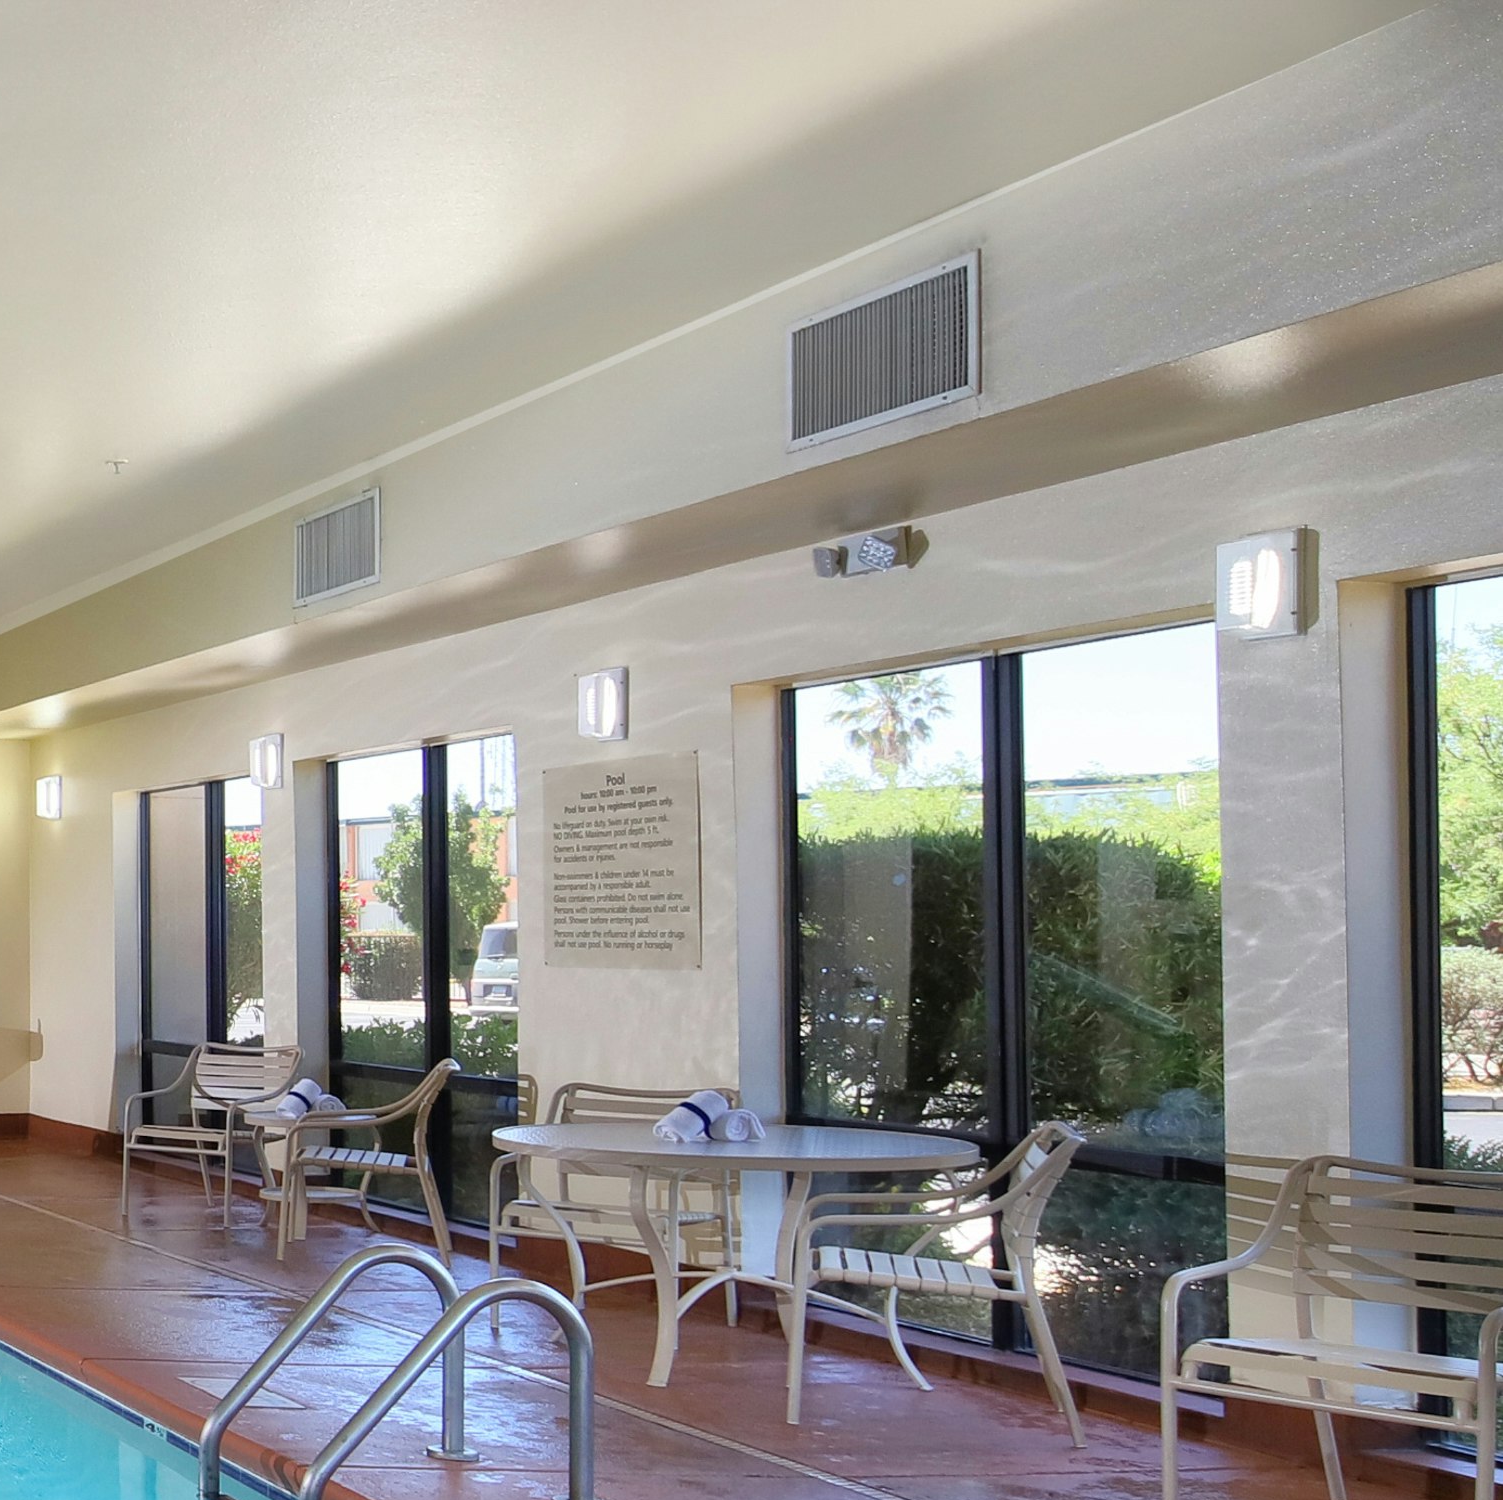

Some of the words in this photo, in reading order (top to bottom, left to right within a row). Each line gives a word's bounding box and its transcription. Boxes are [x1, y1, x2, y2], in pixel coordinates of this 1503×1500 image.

[606, 773, 625, 786] Pool
[564, 806, 577, 814] Pool
[578, 805, 586, 813] for
[598, 803, 605, 812] by
[607, 801, 636, 812] registered
[638, 799, 657, 810] guests
[554, 832, 562, 840] NO
[585, 829, 612, 838] Maximum
[614, 828, 626, 837] pool
[628, 827, 645, 836] depth
[647, 826, 651, 834] 5
[554, 845, 574, 853] Owners
[581, 842, 618, 853] management
[629, 841, 640, 849] not
[641, 838, 673, 849] responsible
[554, 855, 562, 863] for
[563, 854, 587, 862] accidents
[600, 871, 622, 879] children
[623, 870, 640, 878] under
[650, 869, 665, 877] must
[666, 868, 674, 876] be
[554, 883, 588, 892] accompanied
[590, 882, 596, 891] by
[603, 881, 633, 891] responsible
[627, 893, 636, 901] Do
[650, 893, 665, 901] swim
[629, 905, 652, 913] diseases
[653, 904, 666, 913] shall
[569, 916, 589, 924] Shower
[590, 916, 608, 924] before
[610, 916, 633, 926] entering
[554, 930, 574, 938] Persons
[575, 930, 590, 938] under
[592, 930, 601, 938] the
[603, 929, 628, 938] influence
[629, 929, 636, 938] of
[637, 930, 658, 938] alcohol
[554, 940, 566, 948] shall
[613, 942, 635, 951] running
